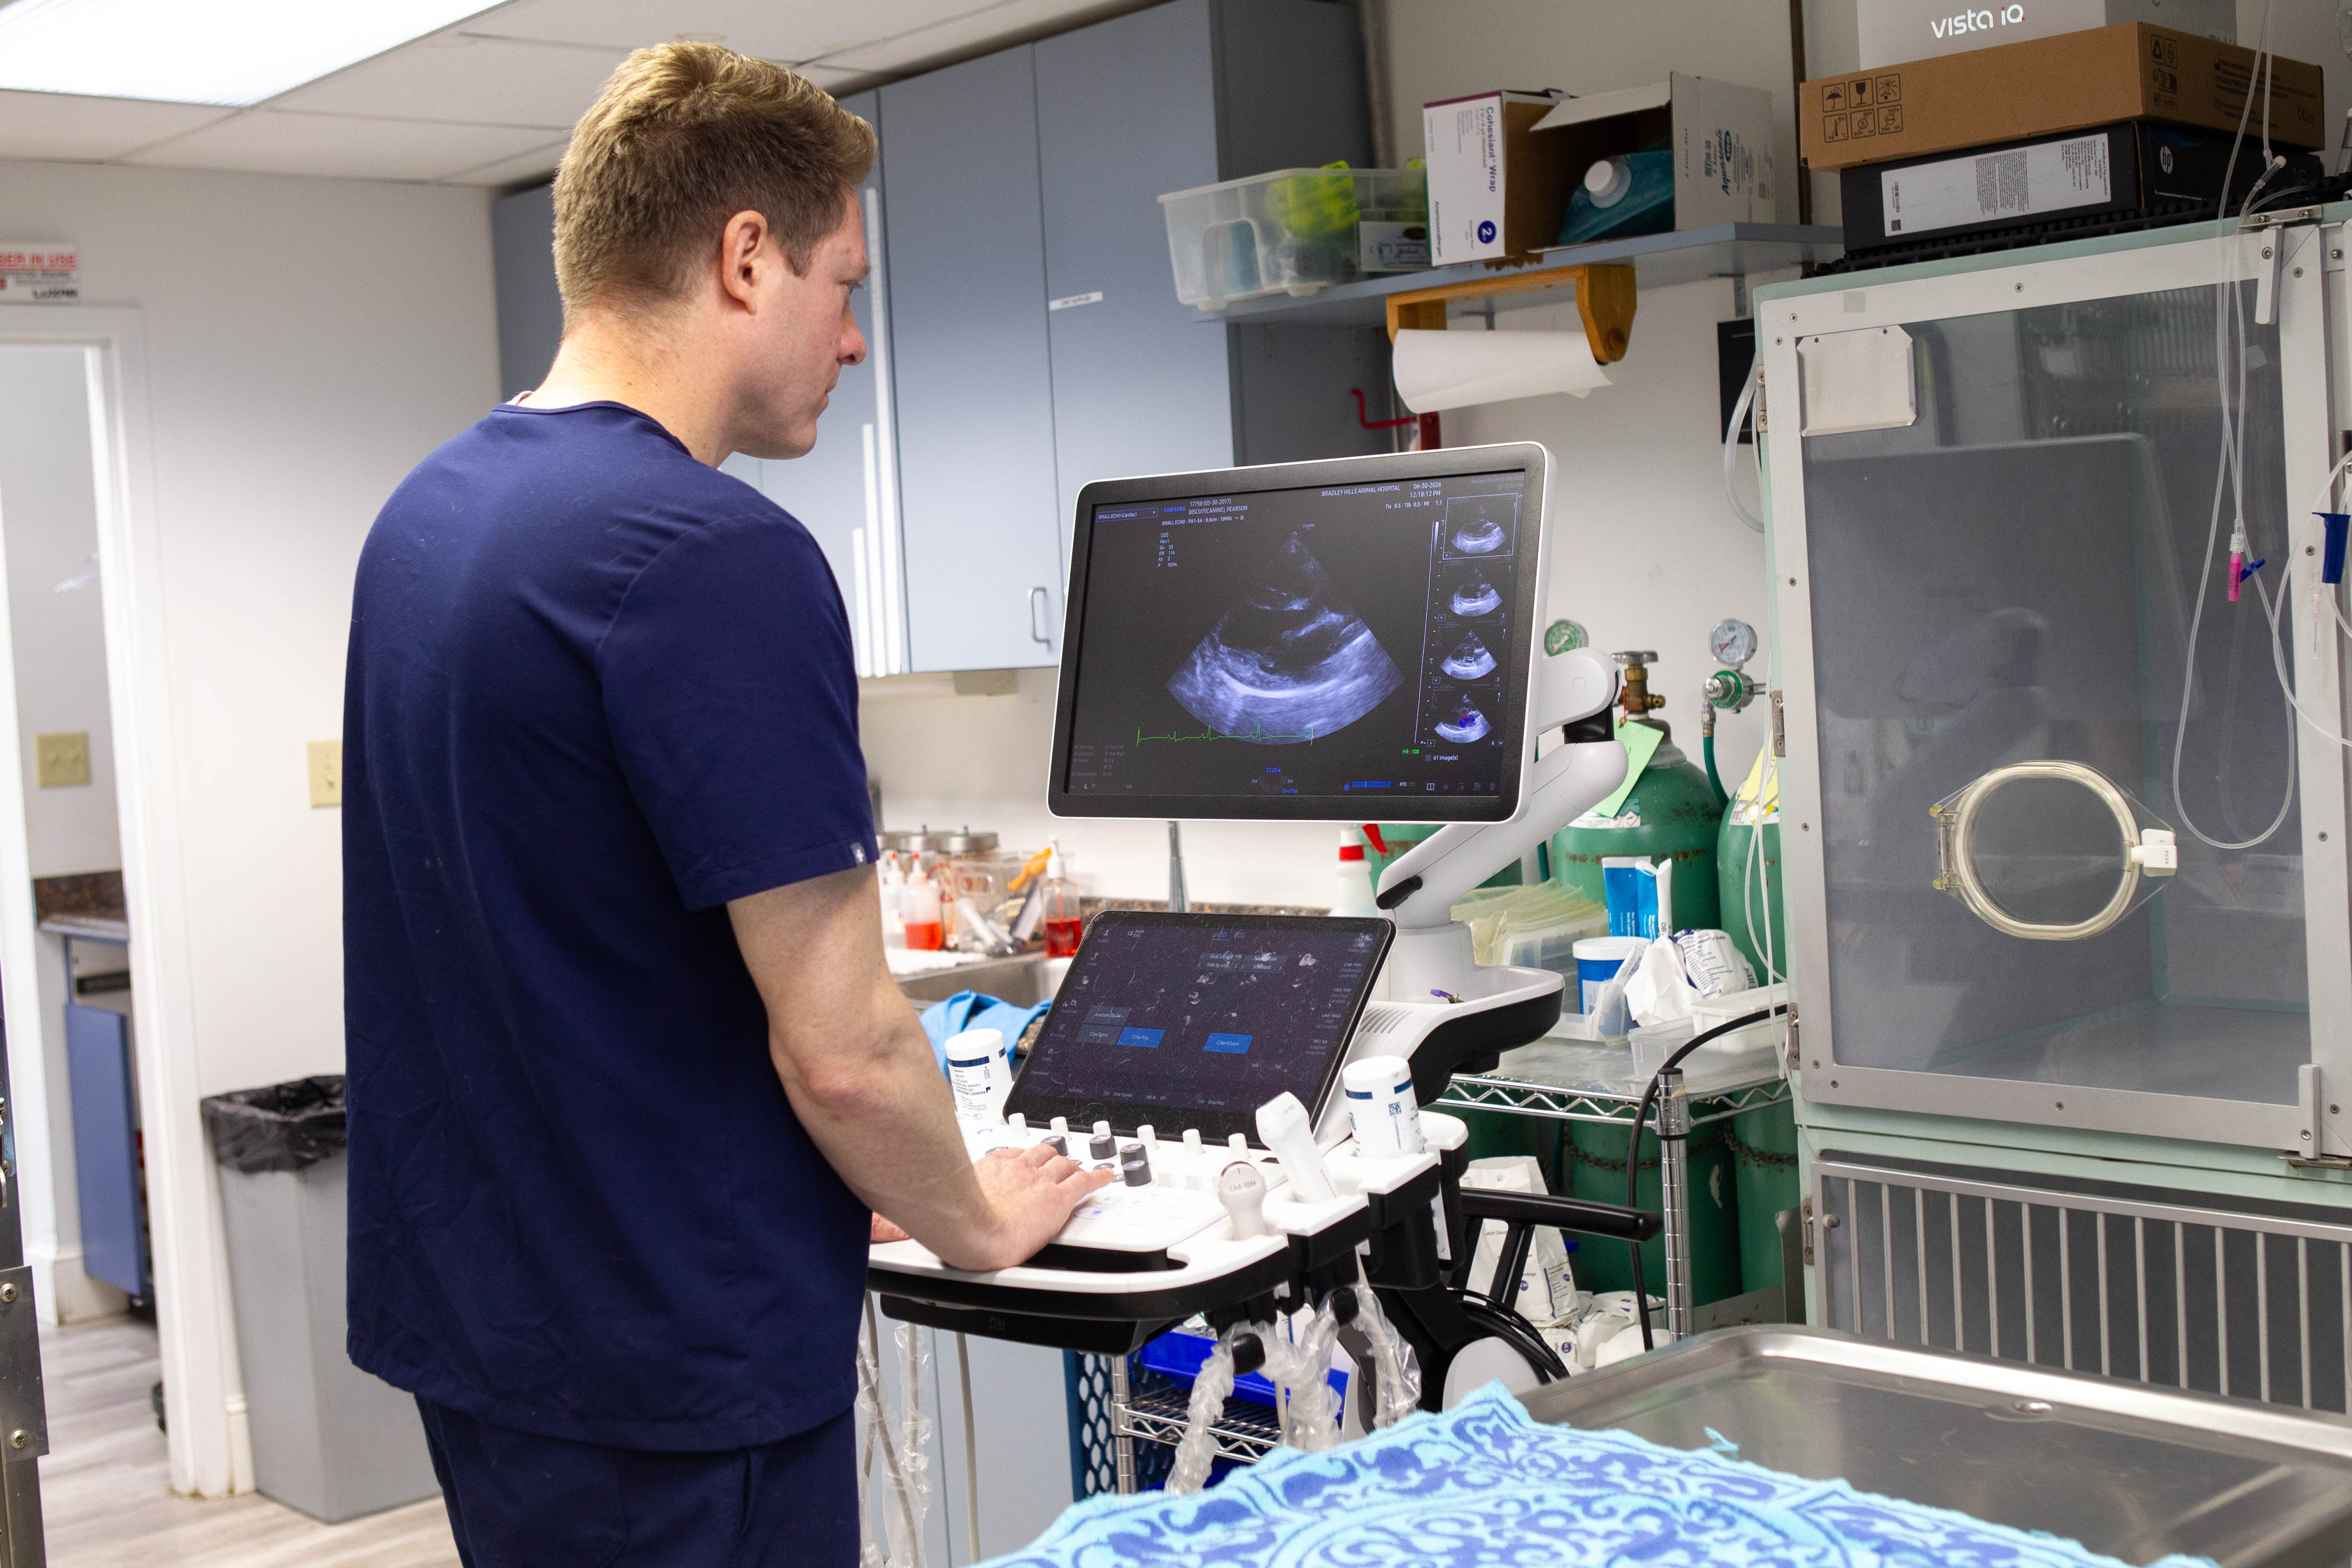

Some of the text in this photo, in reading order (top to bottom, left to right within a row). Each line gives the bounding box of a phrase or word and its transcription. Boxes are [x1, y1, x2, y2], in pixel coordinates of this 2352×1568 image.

[1930, 9, 1993, 38] vista
[1482, 227, 1492, 236] 2
[1229, 1180, 1257, 1192] CA4-10M
